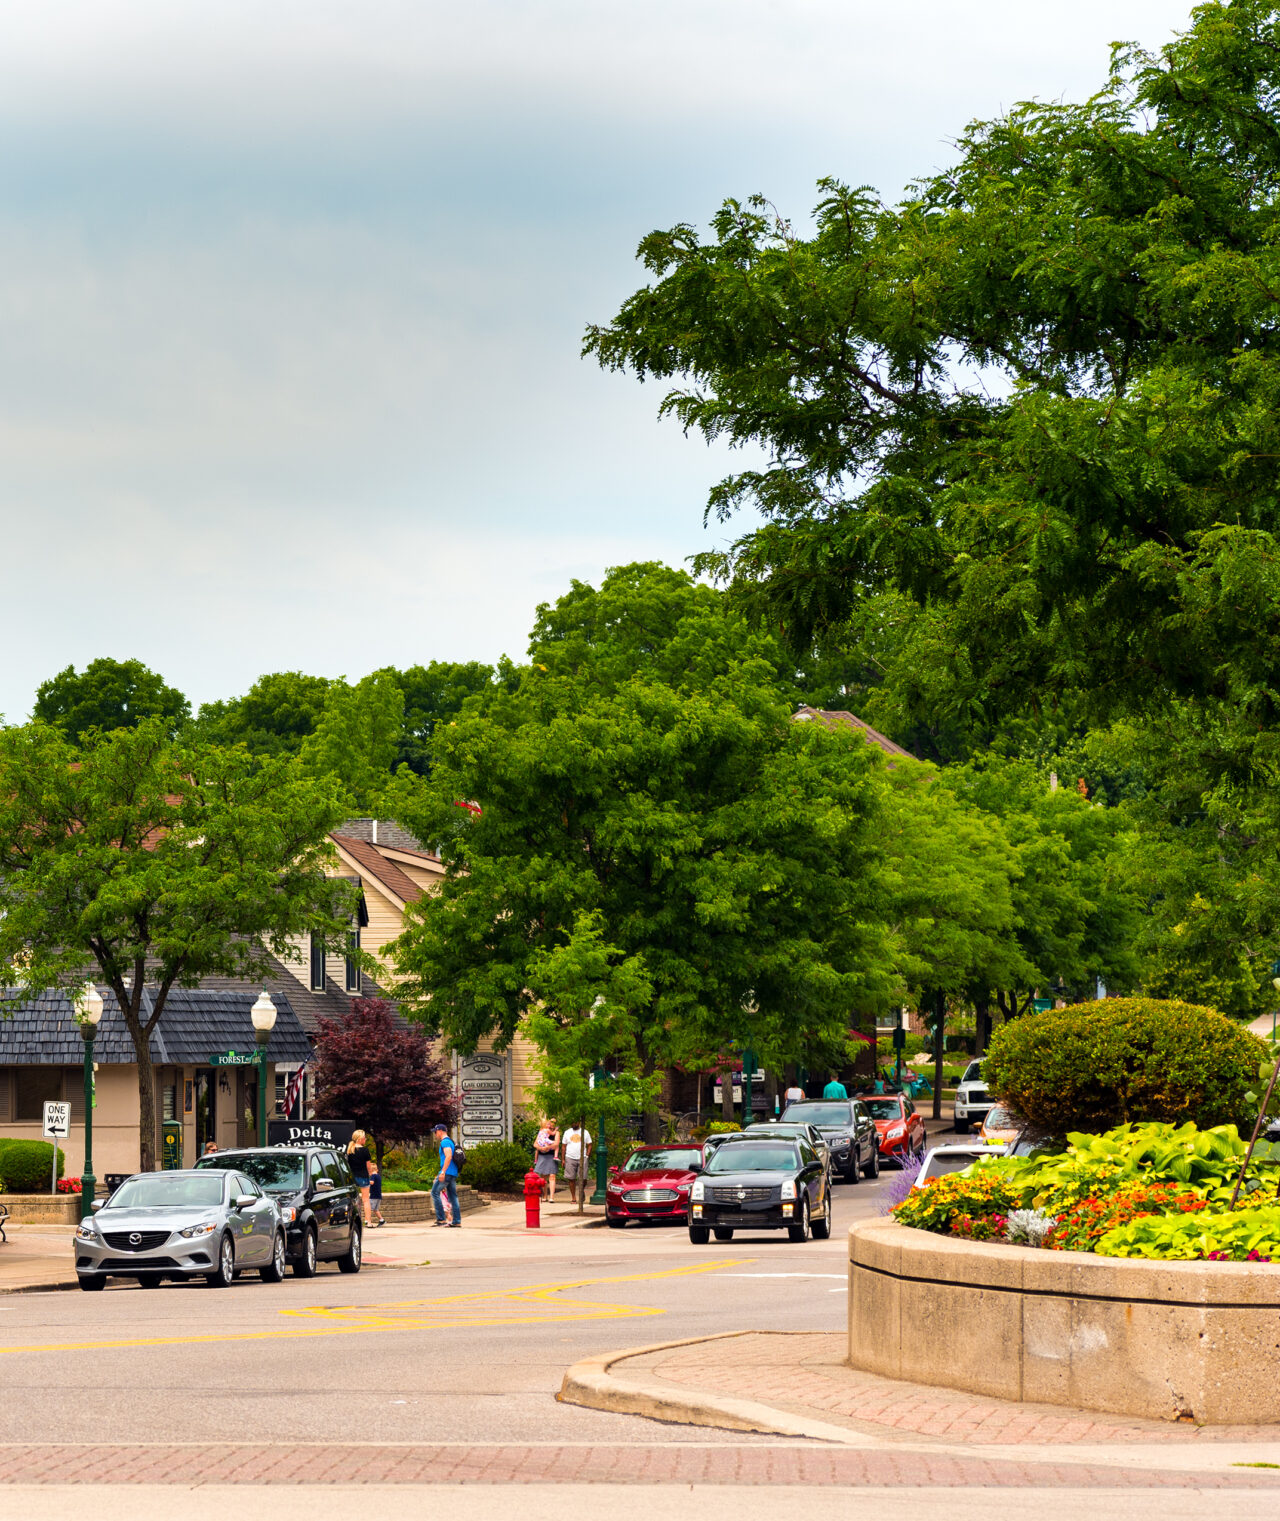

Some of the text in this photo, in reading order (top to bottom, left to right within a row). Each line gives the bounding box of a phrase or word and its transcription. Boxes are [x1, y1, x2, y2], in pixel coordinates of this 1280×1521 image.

[218, 1055, 245, 1064] FOREST
[48, 1105, 66, 1115] ONE
[47, 1115, 66, 1124] WAY
[288, 1125, 332, 1140] Delta
